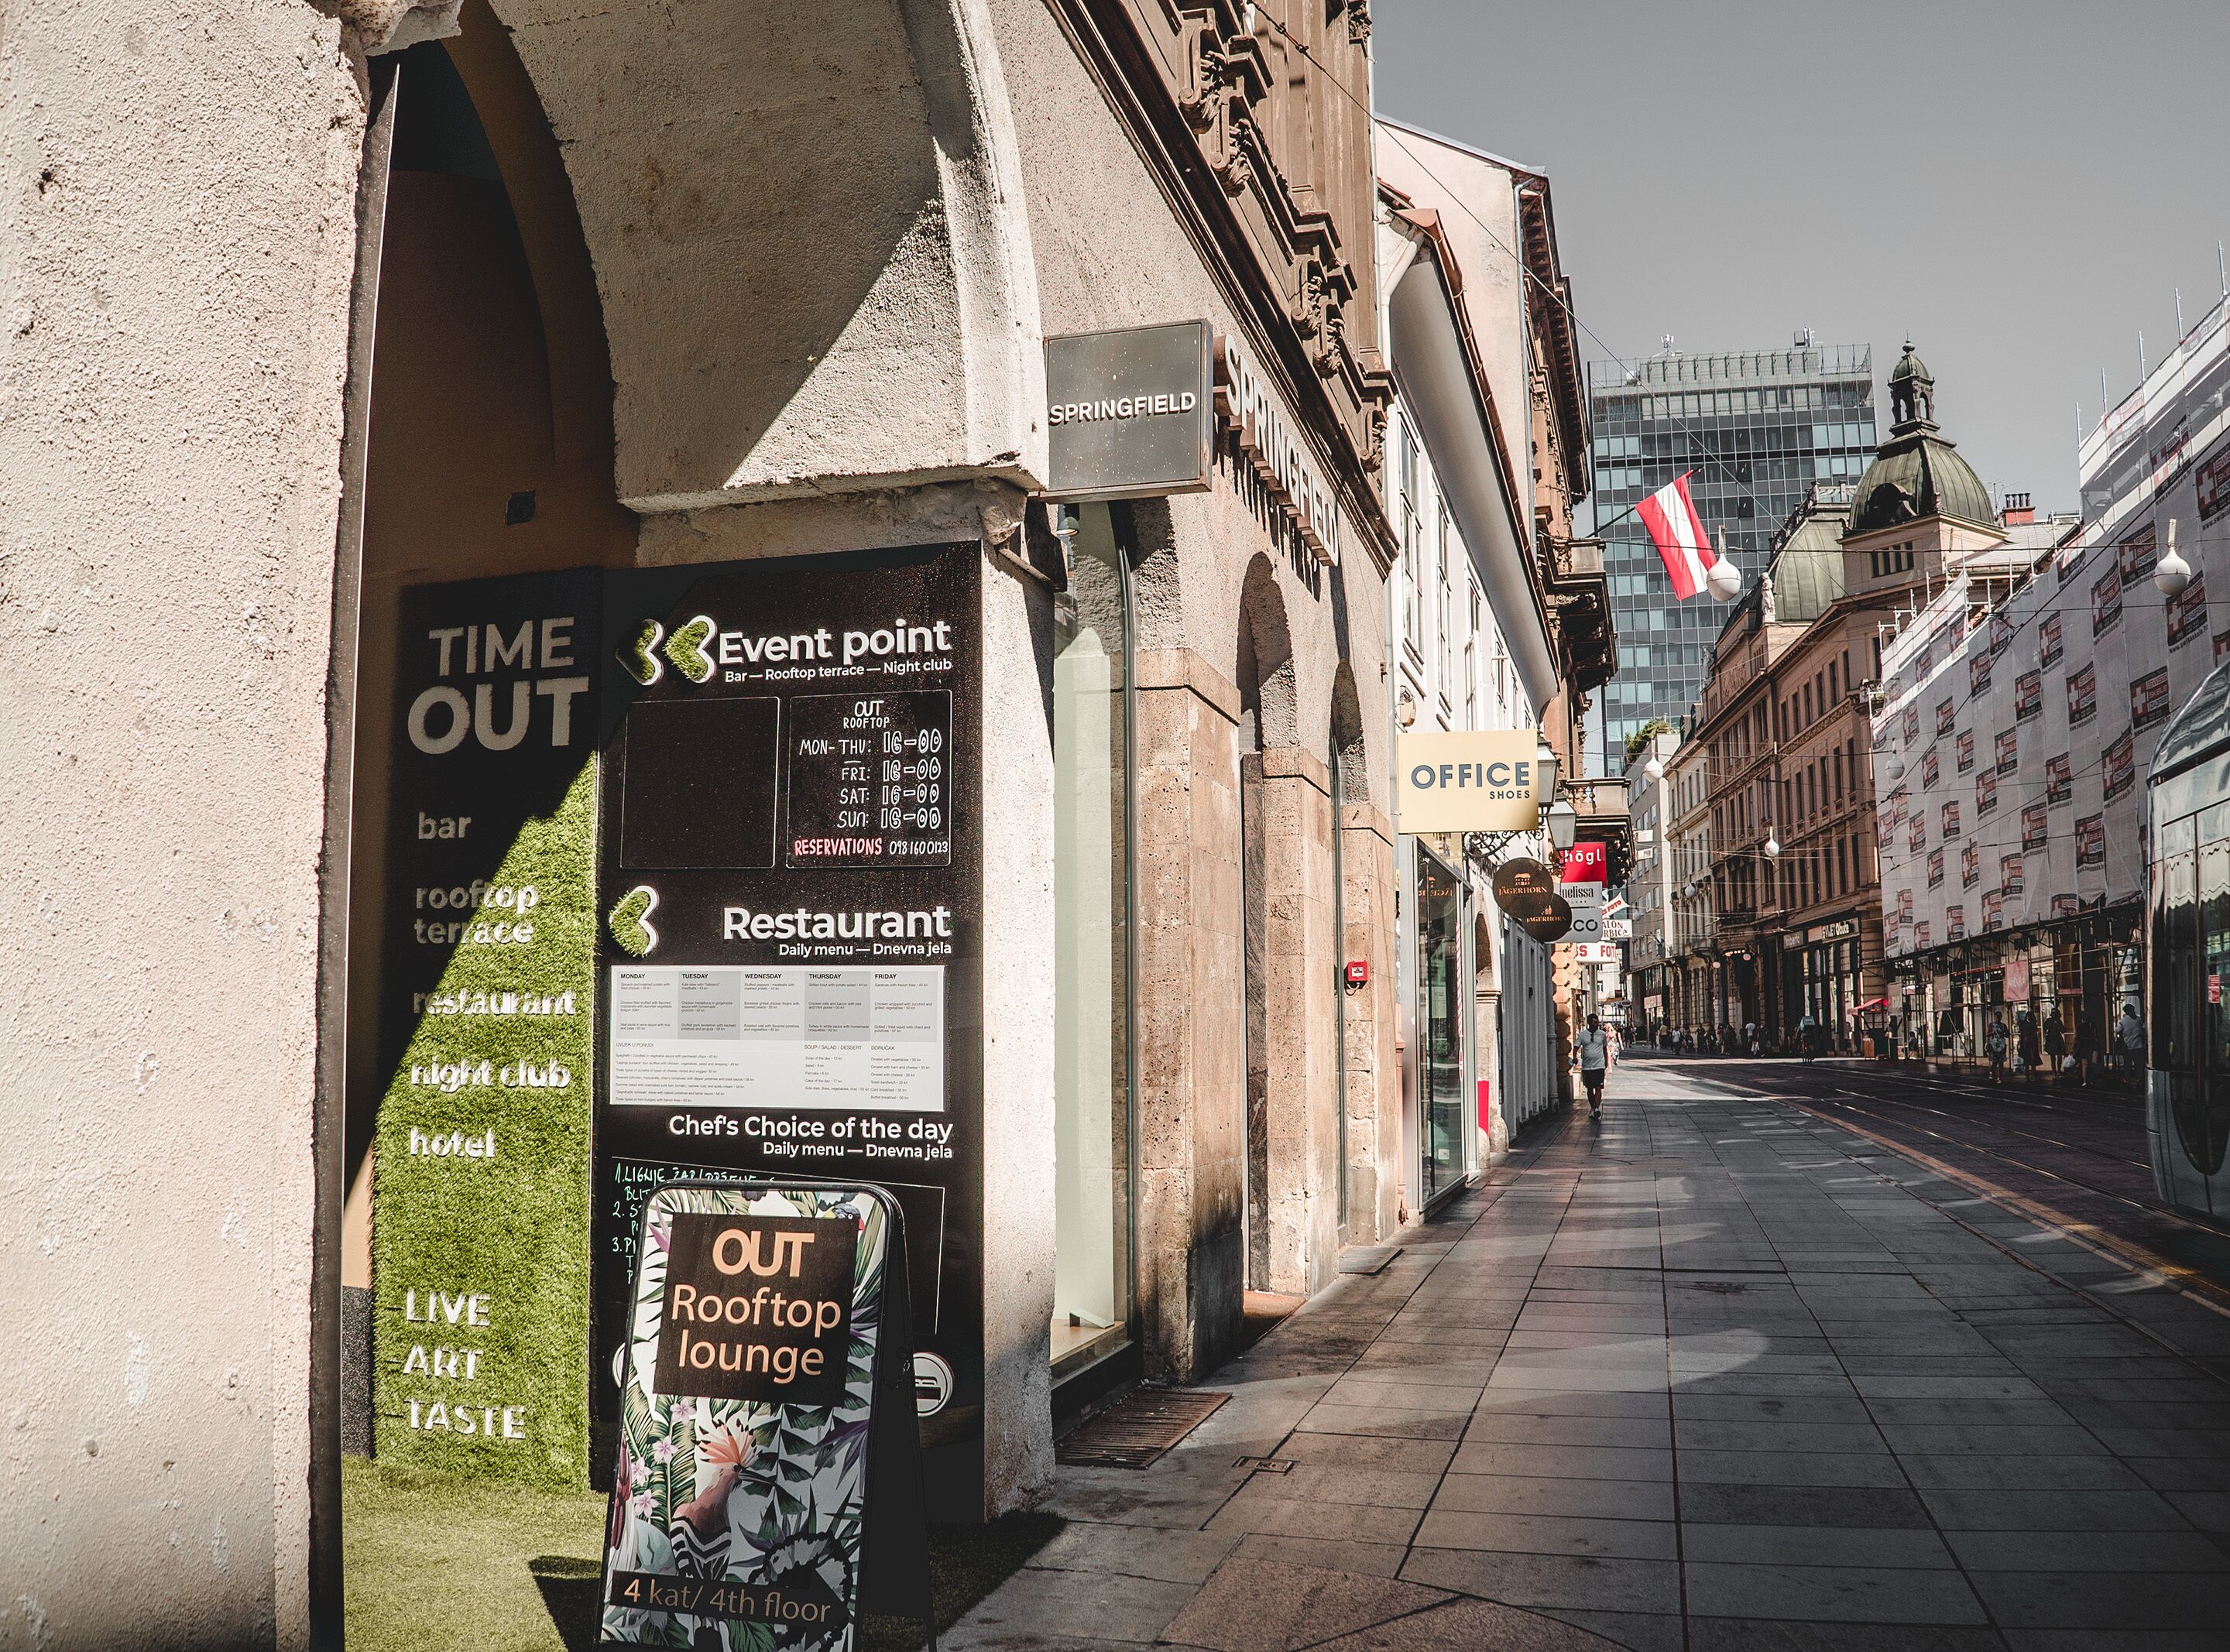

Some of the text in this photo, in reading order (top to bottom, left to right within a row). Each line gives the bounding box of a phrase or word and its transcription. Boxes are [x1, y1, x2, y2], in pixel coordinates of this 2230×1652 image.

[1048, 392, 1196, 425] SPRINGFIELD
[1225, 334, 1339, 567] SPRINGFIELD
[429, 616, 575, 676] TIME
[719, 619, 952, 666] Event point
[725, 670, 748, 683] Bar
[765, 668, 816, 681] Rooftop
[818, 665, 865, 678] terrace
[883, 660, 921, 675] Night
[923, 658, 952, 672] club
[407, 676, 588, 755] OUT
[842, 717, 890, 729] ROOFTOP
[854, 700, 885, 718] OUT
[1411, 762, 1531, 790] OFFICE
[1488, 790, 1531, 800] SHOES
[418, 811, 472, 840] bar
[794, 838, 883, 856] RESERVATIONS
[416, 879, 540, 915] rooftop
[1498, 886, 1548, 896] JÄGERHORN
[1607, 900, 1622, 912] FOTO
[414, 919, 534, 946] terrace
[723, 906, 952, 940] Restaurant
[778, 943, 811, 958] Daily
[814, 945, 853, 956] menu
[873, 943, 925, 955] Dnevna
[925, 941, 952, 958] jela
[413, 989, 578, 1016] restaurant
[410, 1058, 571, 1093] night club
[409, 1126, 497, 1158] hotel
[669, 1115, 954, 1144] Chef's Choice of the day
[763, 1142, 799, 1158] Daily
[801, 1144, 845, 1157] menu
[866, 1143, 922, 1158] Dnevna
[925, 1144, 953, 1161] jela
[712, 1228, 815, 1278] OUT
[671, 1284, 841, 1338] Rooftop
[679, 1328, 824, 1384] lounge
[624, 1580, 641, 1602] 4
[709, 1587, 756, 1616] 4th
[763, 1591, 832, 1623] floor
